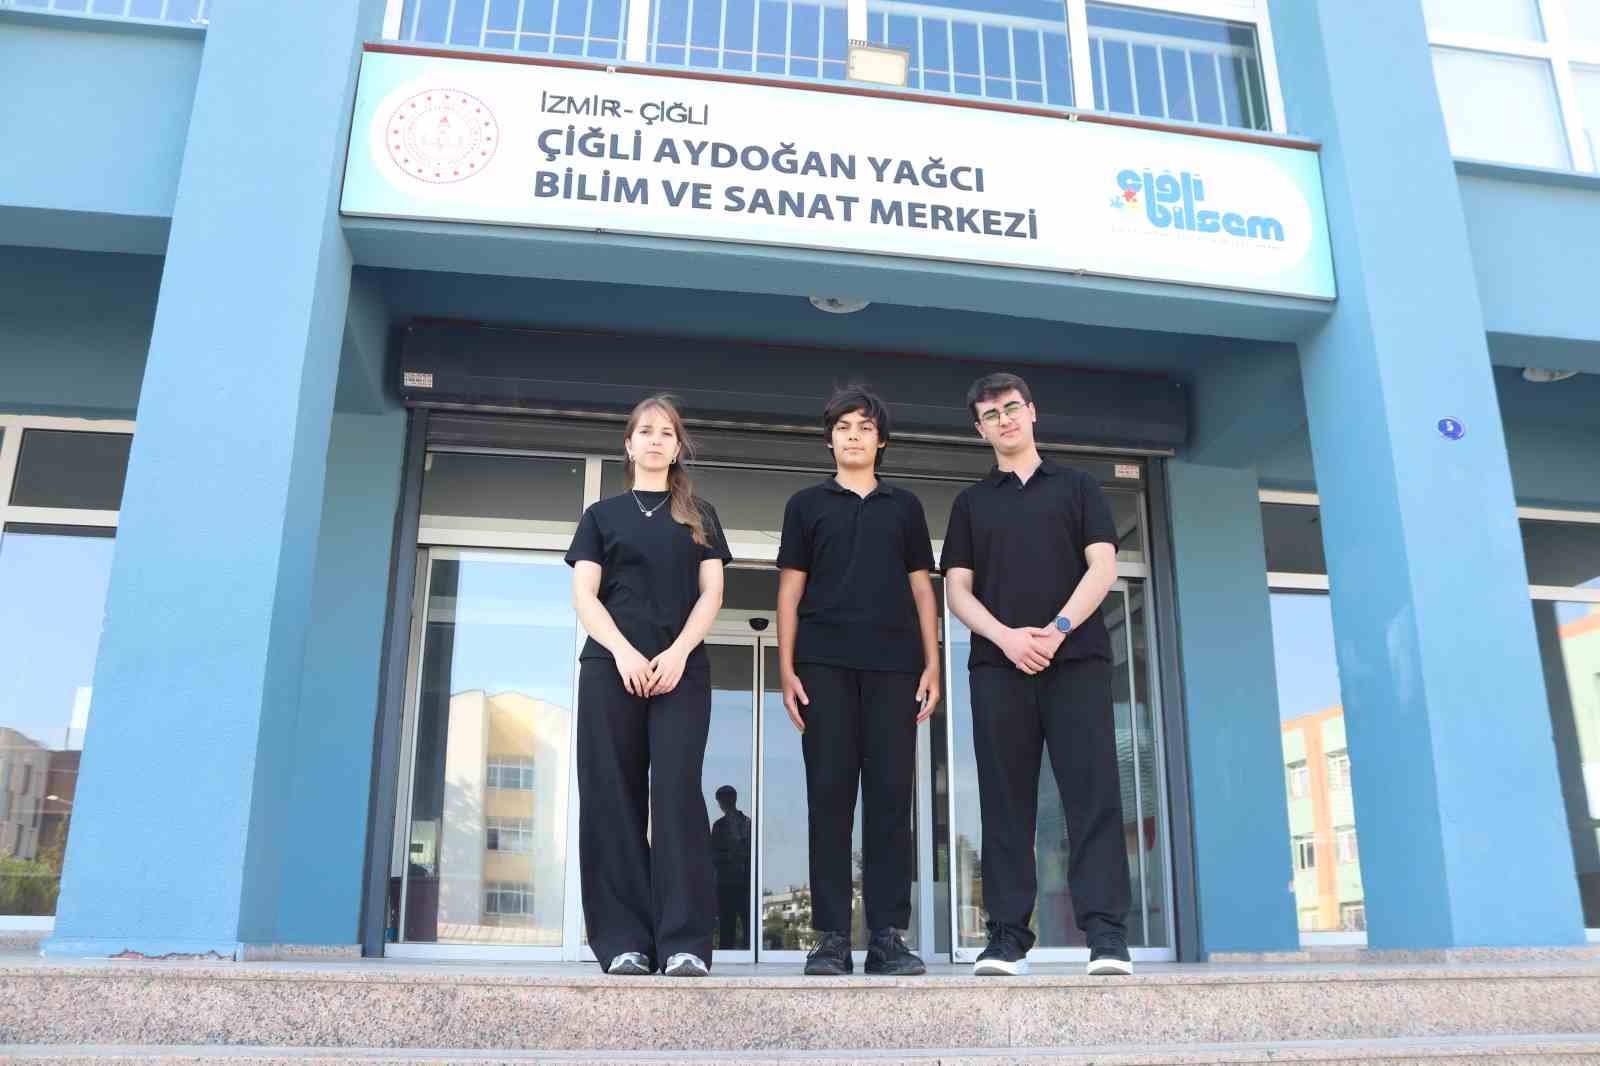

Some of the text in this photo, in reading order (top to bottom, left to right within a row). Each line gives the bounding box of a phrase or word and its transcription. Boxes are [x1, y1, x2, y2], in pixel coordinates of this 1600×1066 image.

[537, 124, 984, 192] ÇİĞLİ AYDOĞAN YAĞCI
[534, 167, 1037, 240] BİLİM VE SANAT MERKEZİ
